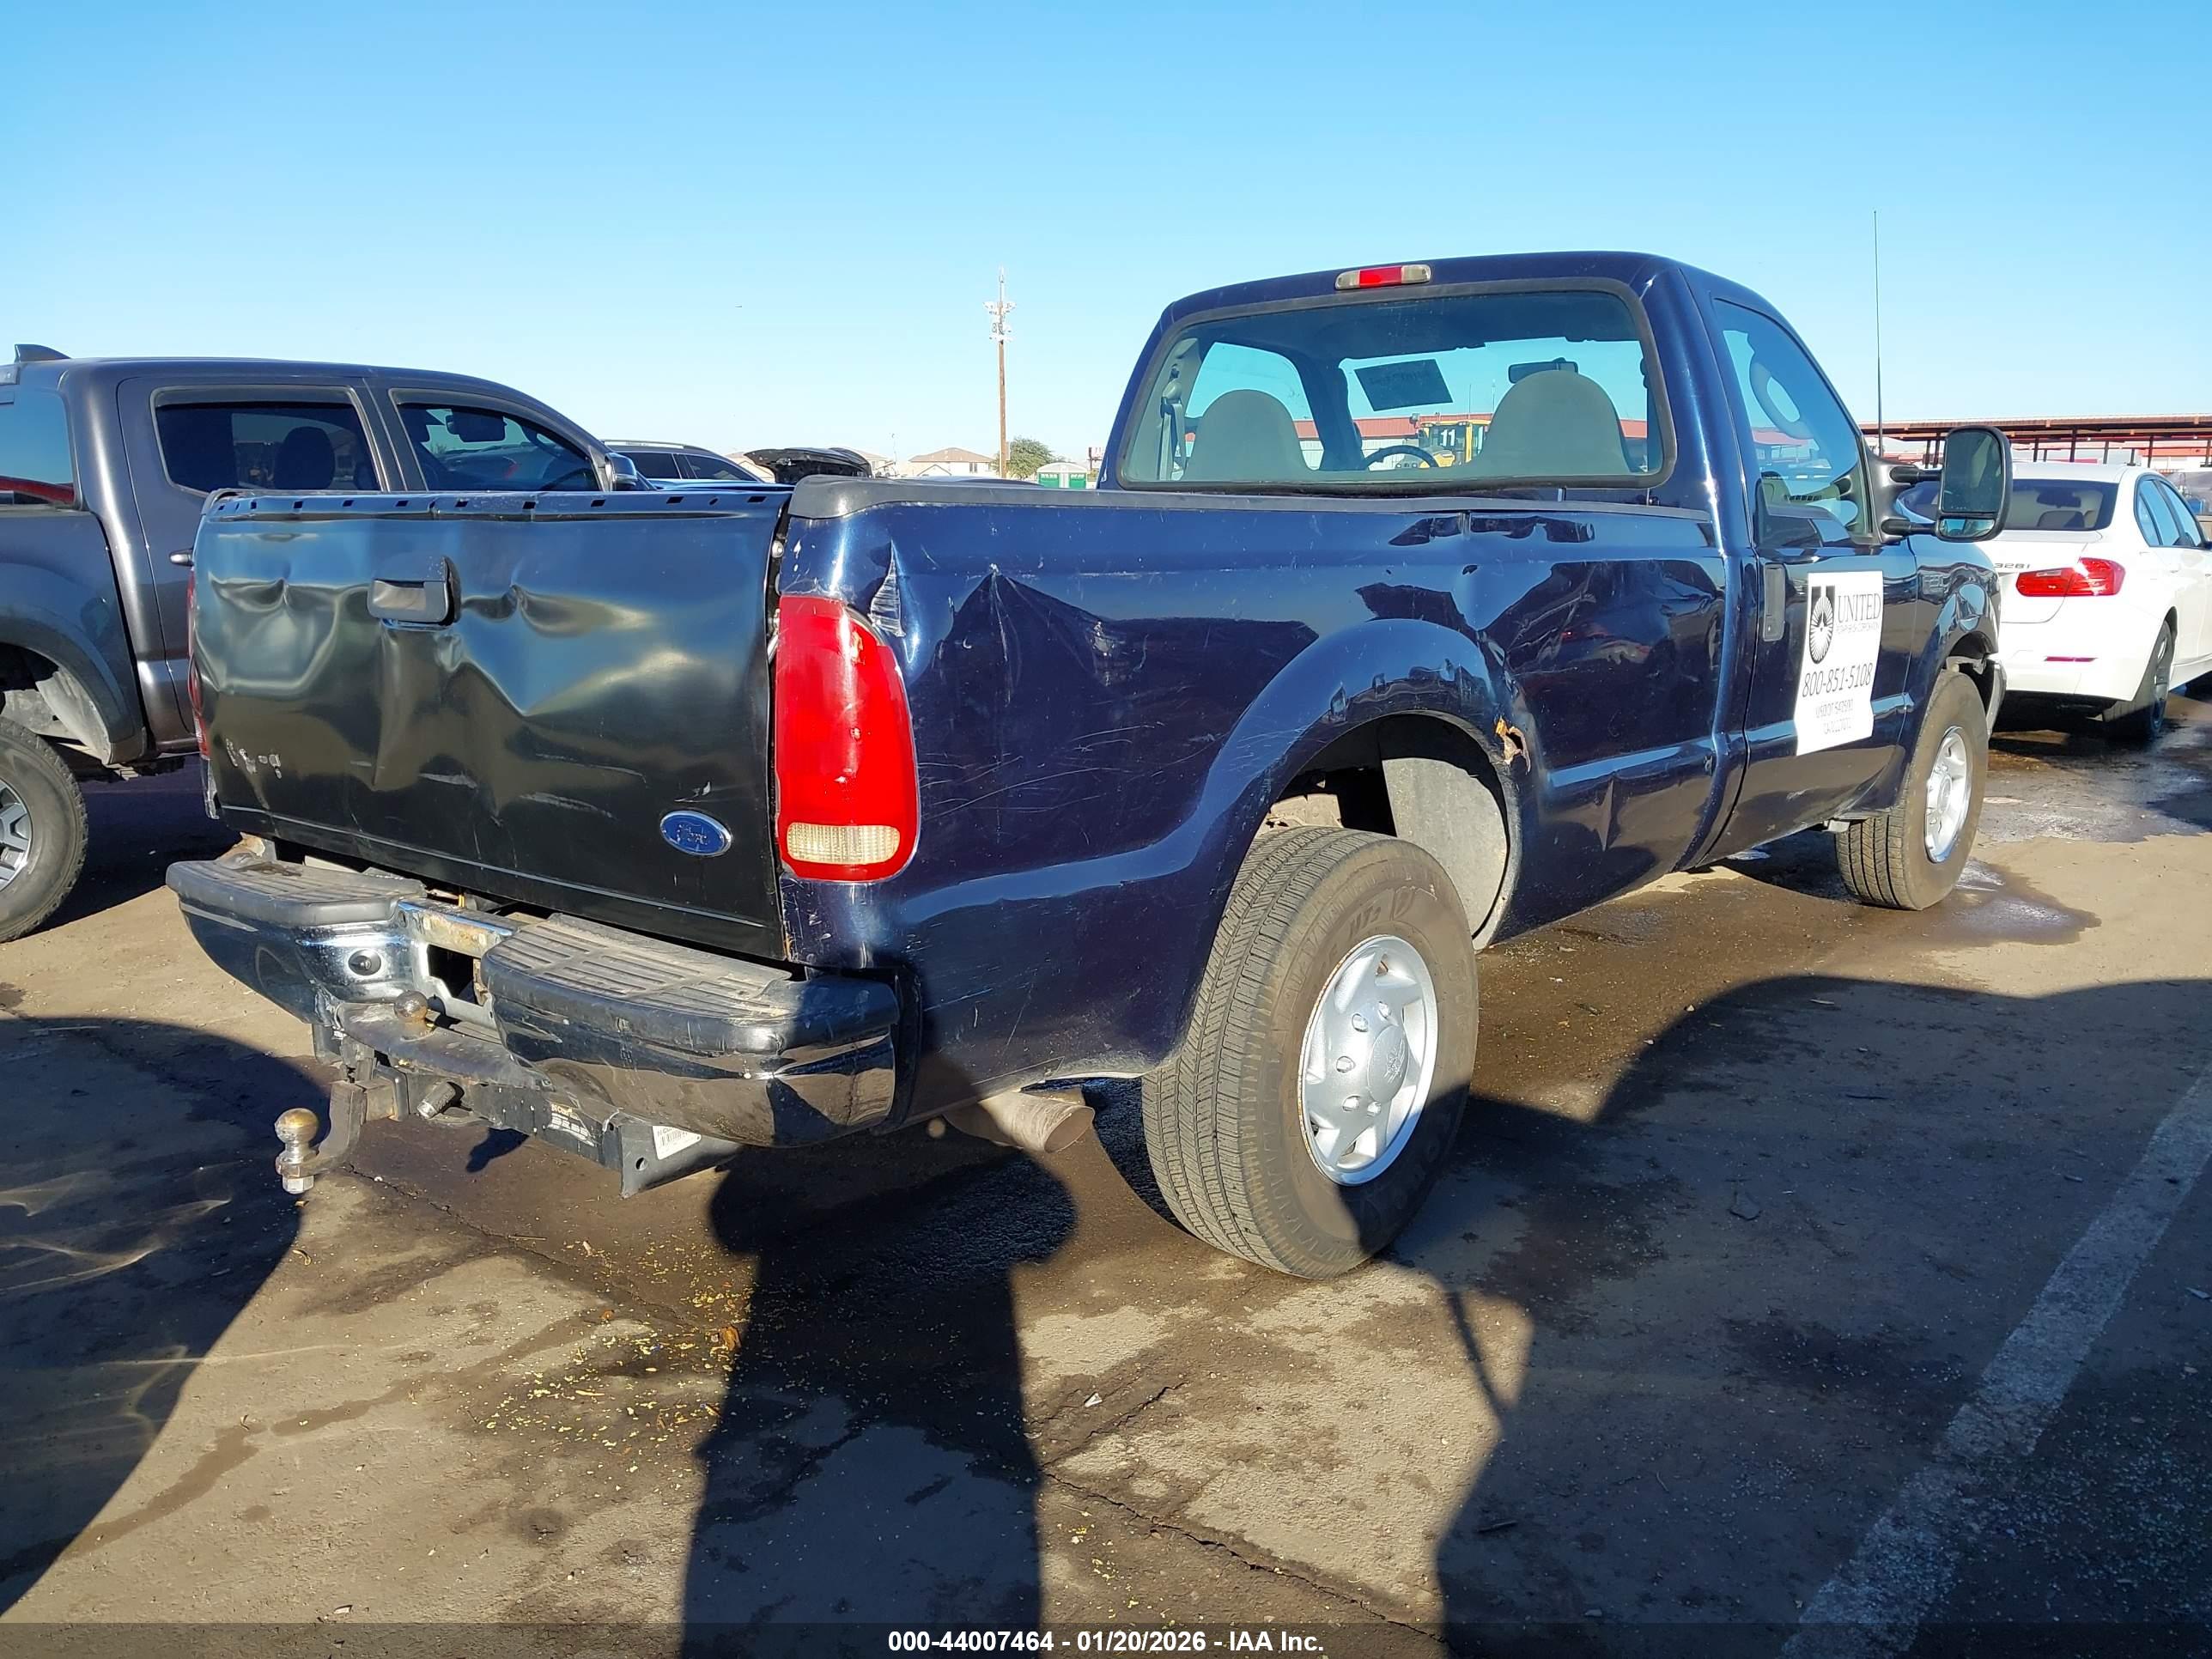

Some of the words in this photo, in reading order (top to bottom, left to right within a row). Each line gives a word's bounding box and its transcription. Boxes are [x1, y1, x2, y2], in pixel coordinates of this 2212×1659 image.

[1440, 428, 1455, 447] 11
[1838, 592, 1881, 623] UNITED
[1802, 662, 1874, 698] 800-851-5108
